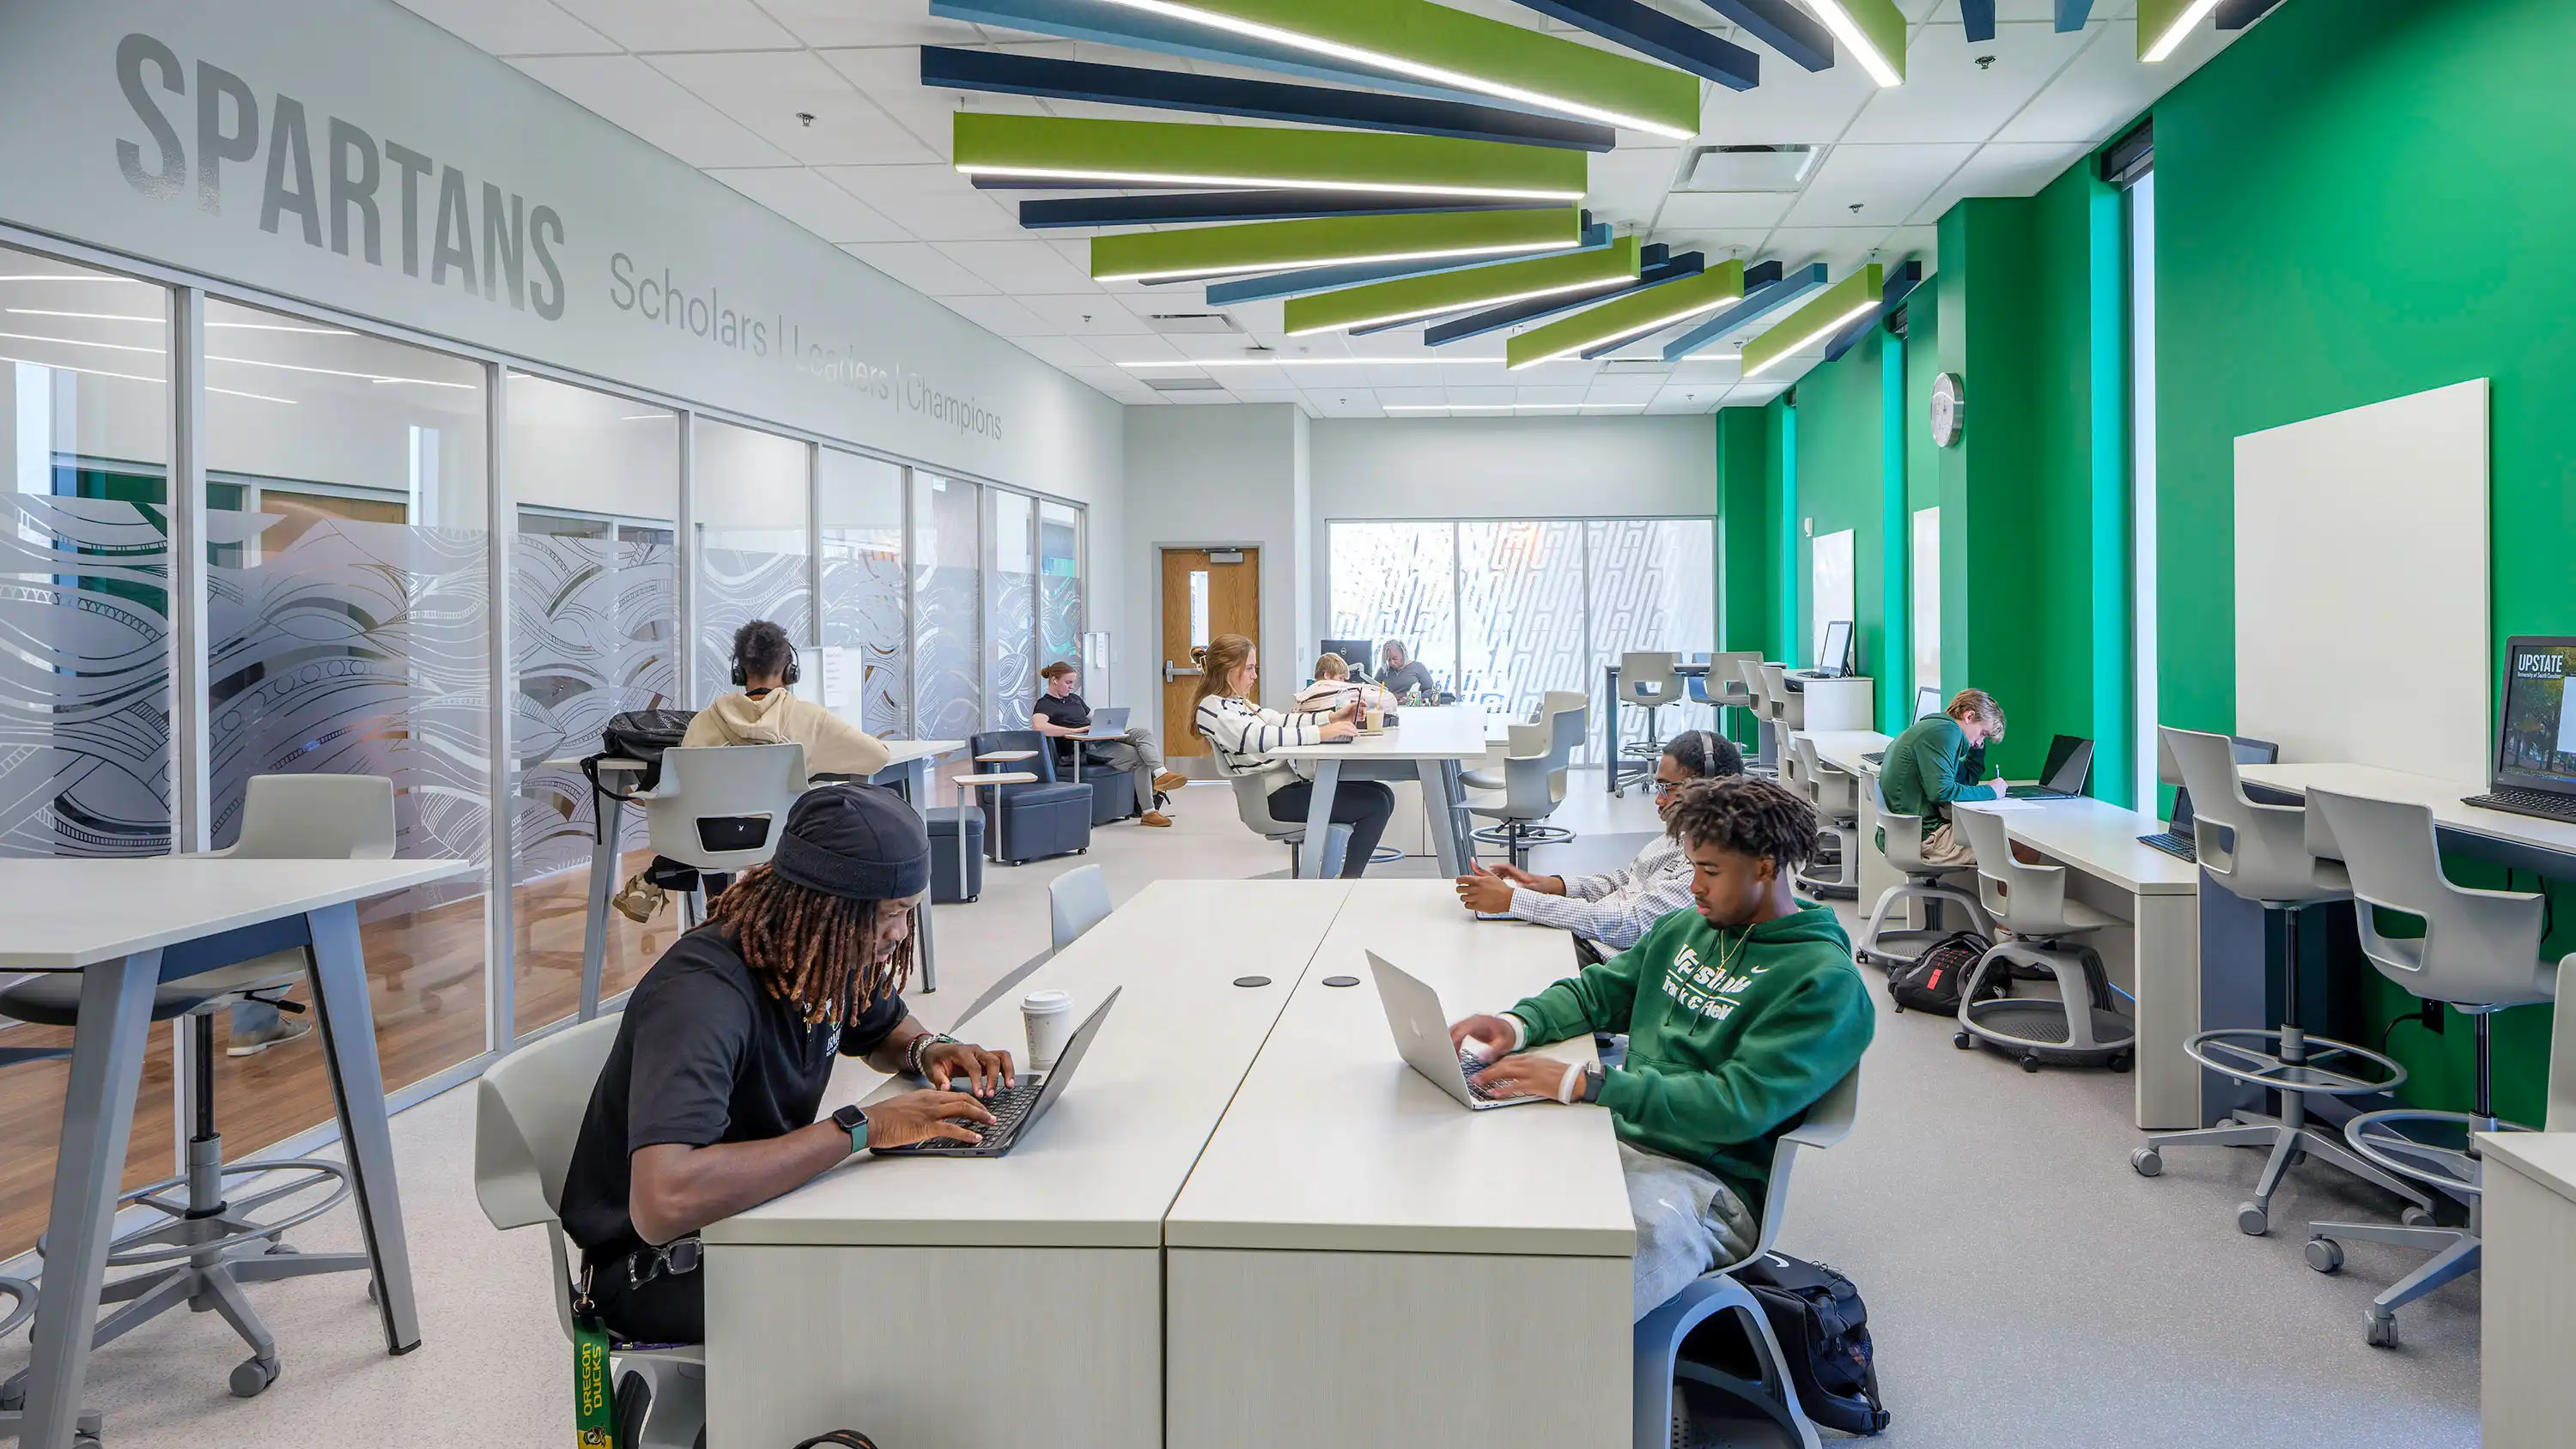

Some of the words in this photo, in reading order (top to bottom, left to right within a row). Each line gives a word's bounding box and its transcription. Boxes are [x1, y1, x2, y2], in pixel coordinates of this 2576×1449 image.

[115, 33, 566, 322] SPARTANS
[610, 252, 768, 358] Scholars
[794, 324, 890, 401] Leaders
[907, 372, 1003, 440] Champions
[2518, 654, 2563, 672] UPSTATE
[1662, 975, 1689, 1006] Trak
[1686, 995, 1703, 1010] &
[581, 1342, 592, 1416] OREGON
[592, 1345, 602, 1408] DUCKS
